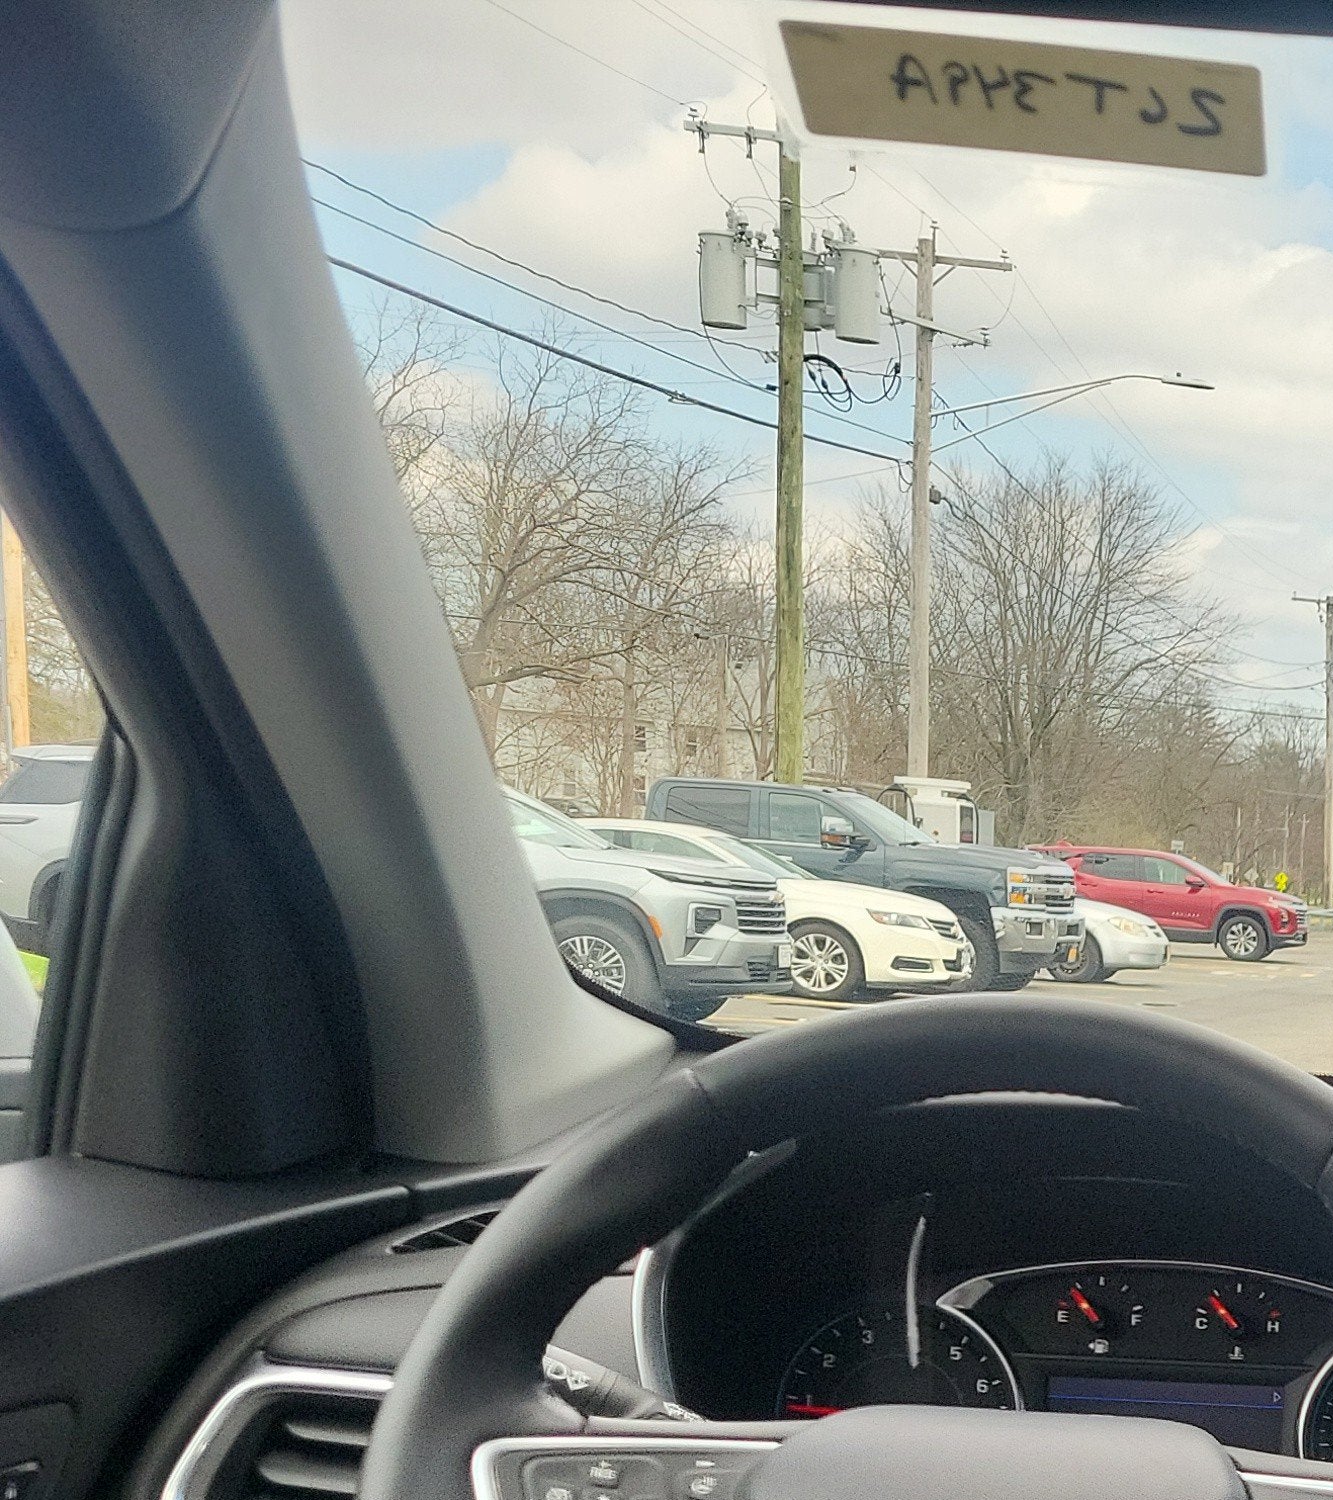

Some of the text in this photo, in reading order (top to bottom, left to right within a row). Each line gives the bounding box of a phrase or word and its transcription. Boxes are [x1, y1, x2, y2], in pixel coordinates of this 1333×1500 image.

[1057, 1310, 1068, 1323] E
[1131, 1314, 1142, 1326] F
[1195, 1317, 1208, 1330] C
[1267, 1321, 1279, 1333] H
[862, 1330, 874, 1344] 3
[950, 1346, 962, 1361] 5
[823, 1354, 836, 1368] 2
[976, 1379, 989, 1393] 6
